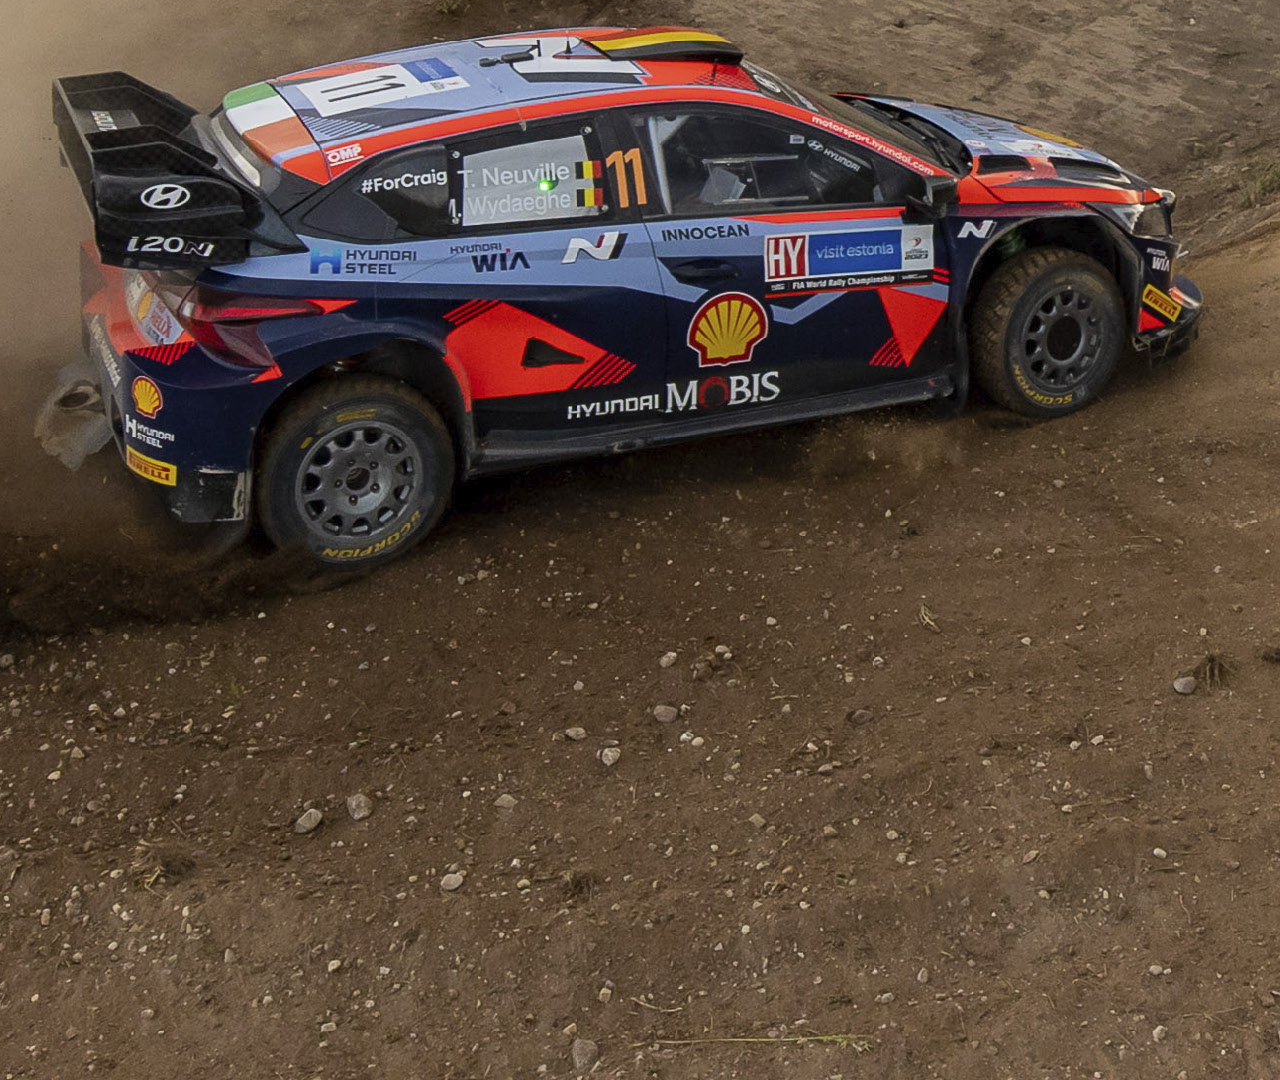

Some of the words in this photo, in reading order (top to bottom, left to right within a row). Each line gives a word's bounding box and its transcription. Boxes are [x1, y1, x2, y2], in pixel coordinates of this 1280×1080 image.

[327, 145, 362, 163] OMP
[811, 115, 934, 176] motorsport.hyundai.com
[823, 147, 861, 172] HYUNDAI
[361, 169, 448, 194] #ForCraig
[482, 162, 570, 187] Neuville
[605, 147, 648, 209] 11
[467, 192, 571, 219] Wydaeghe
[661, 223, 750, 243] INNOCEAN
[346, 249, 417, 262] HYUNDAI
[450, 242, 502, 255] HYUNDAI
[471, 247, 531, 273] WIA
[769, 237, 805, 277] HY
[816, 246, 846, 260] visit
[846, 242, 895, 258] estonia
[345, 263, 397, 275] STEEL
[792, 281, 805, 290] FIA
[567, 394, 660, 420] HYUNDAI
[665, 371, 782, 413] MOBIS
[1013, 365, 1073, 406] SCORPION
[136, 432, 163, 449] STEEL
[137, 422, 175, 442] HYUNDAI
